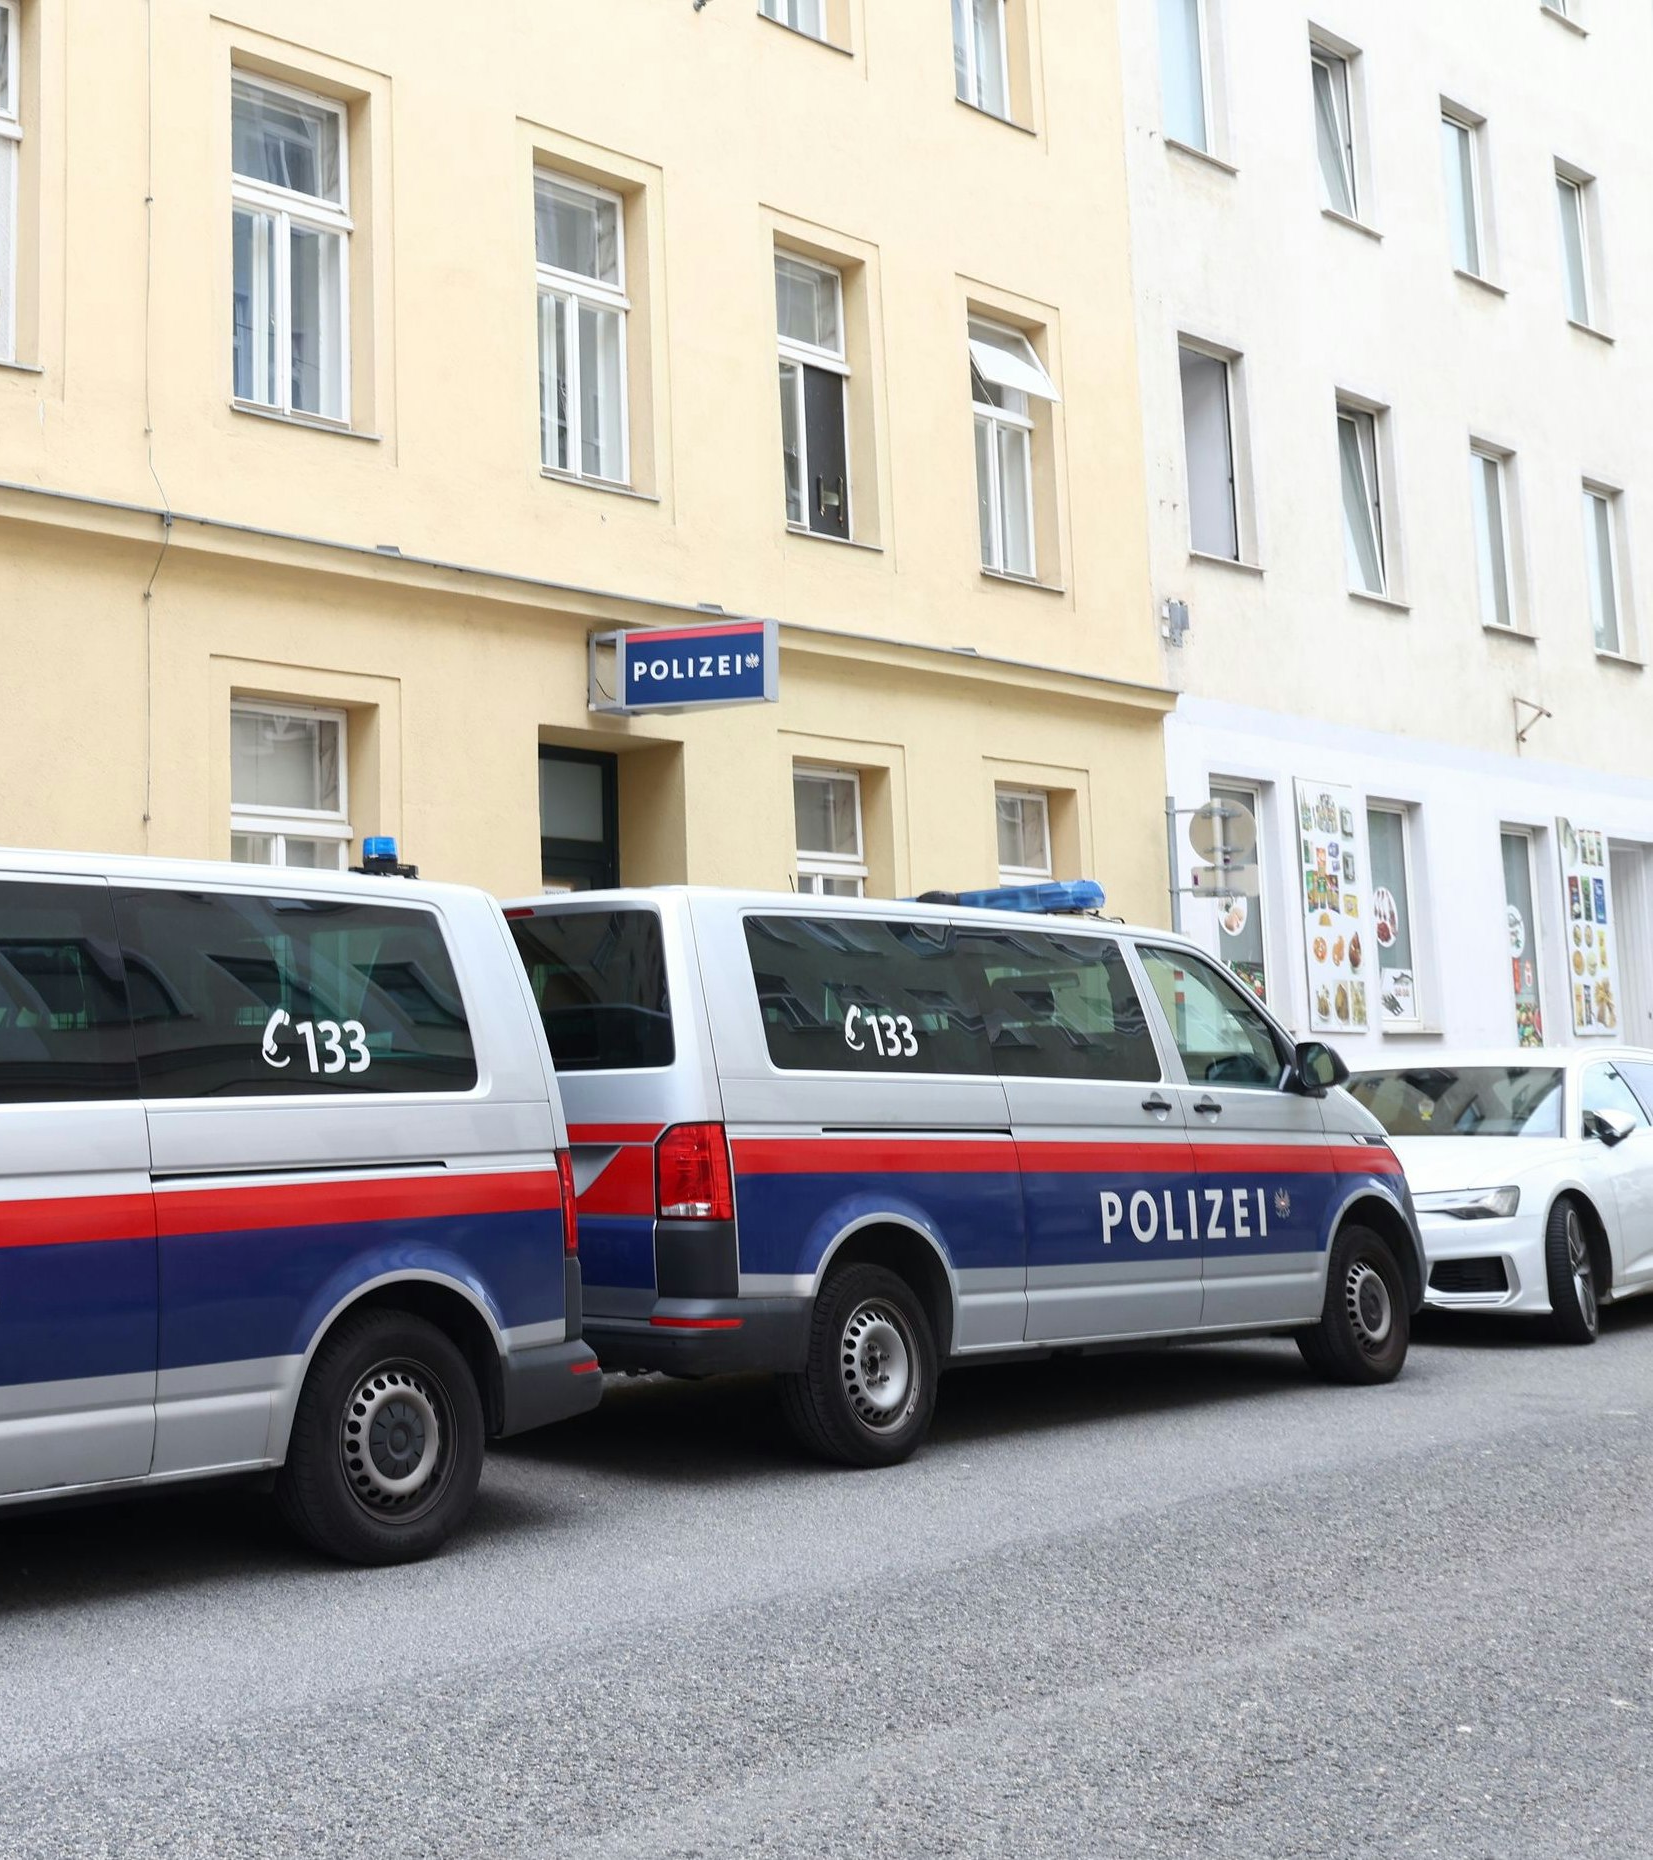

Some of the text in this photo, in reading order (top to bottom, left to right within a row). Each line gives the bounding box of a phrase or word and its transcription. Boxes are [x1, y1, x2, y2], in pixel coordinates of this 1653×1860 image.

[633, 653, 742, 682] POLIZEI
[295, 1019, 371, 1074] 133
[865, 1014, 919, 1057] 133
[1099, 1187, 1268, 1244] POLIZEI
